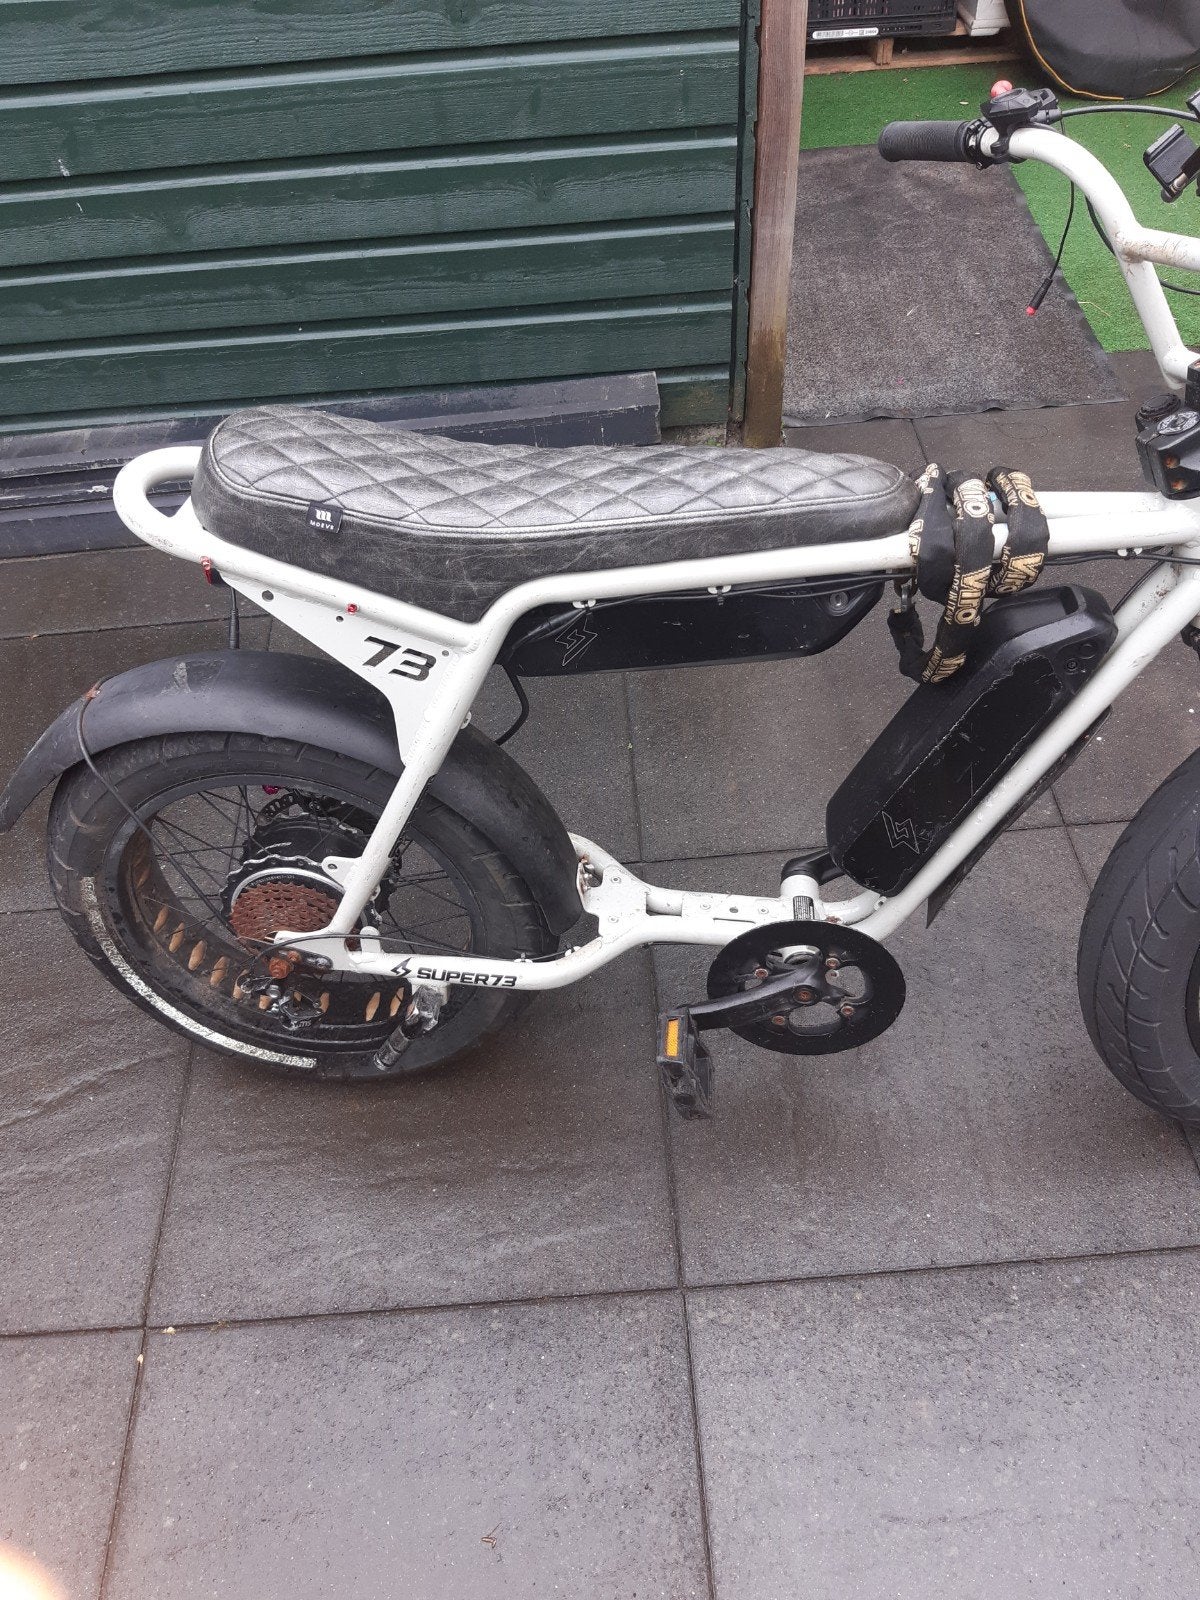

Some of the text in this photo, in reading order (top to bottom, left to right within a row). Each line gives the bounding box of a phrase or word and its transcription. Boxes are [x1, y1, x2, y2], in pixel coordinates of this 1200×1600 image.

[951, 564, 961, 591] MADE
[362, 635, 437, 682] 73
[416, 966, 518, 988] SUPER73
